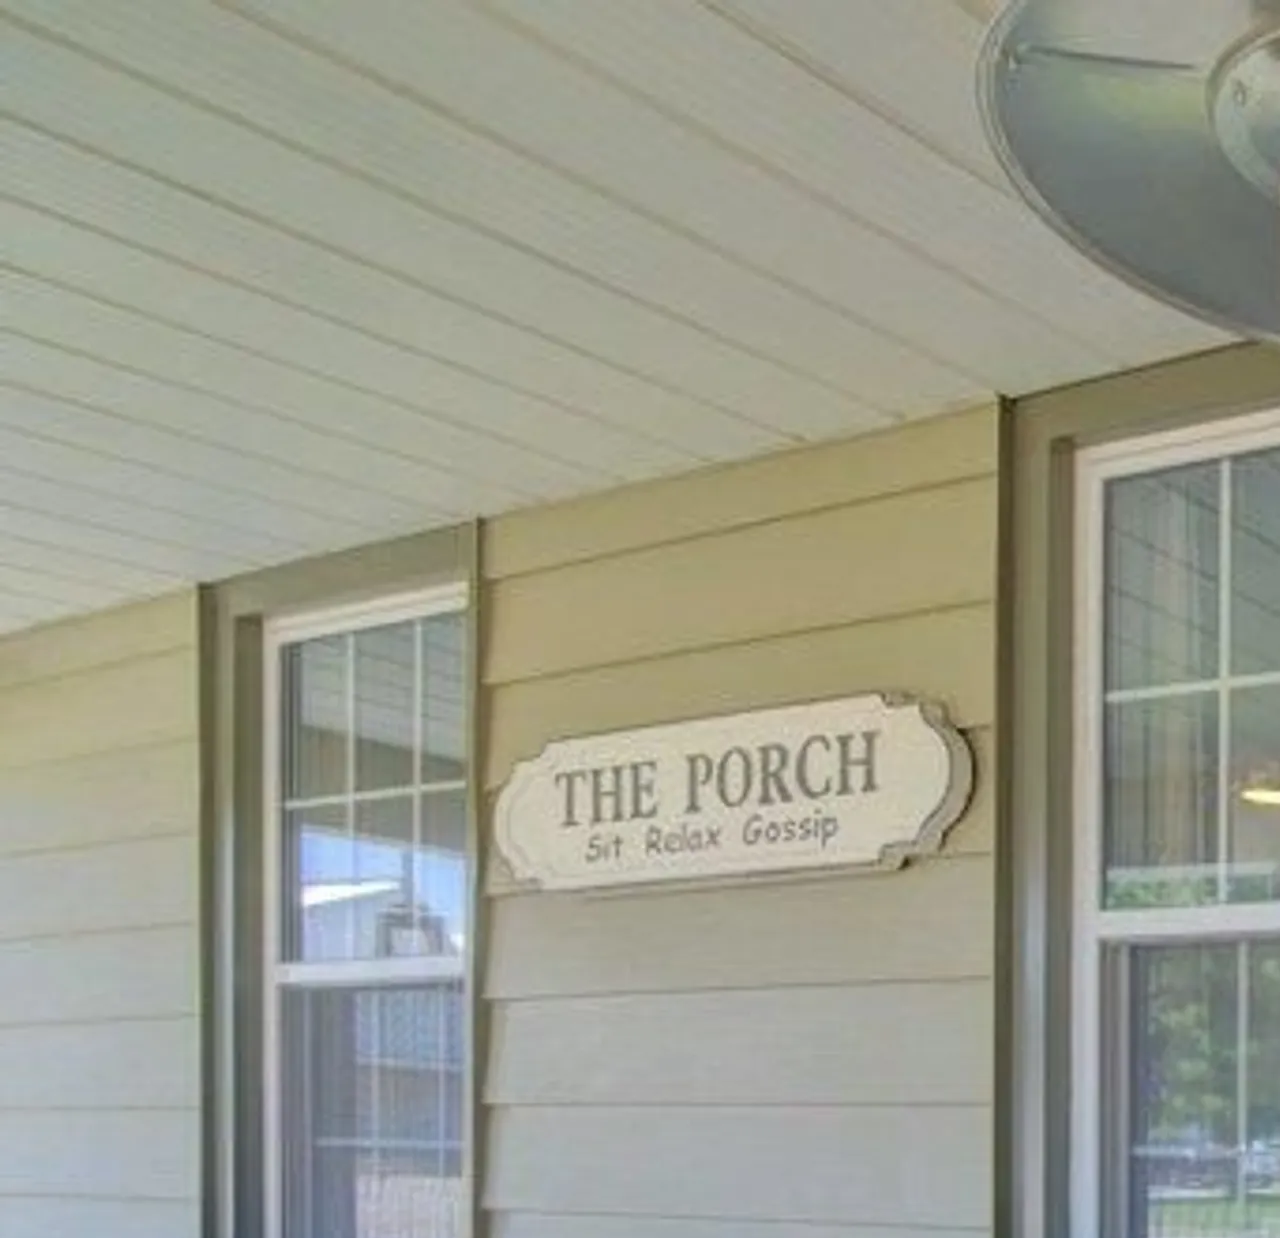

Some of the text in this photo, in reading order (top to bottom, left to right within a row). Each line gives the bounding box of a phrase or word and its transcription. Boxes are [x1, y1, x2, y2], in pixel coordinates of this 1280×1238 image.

[555, 731, 880, 827] THE PORCH
[584, 807, 839, 862] Sit Relax Gossip
